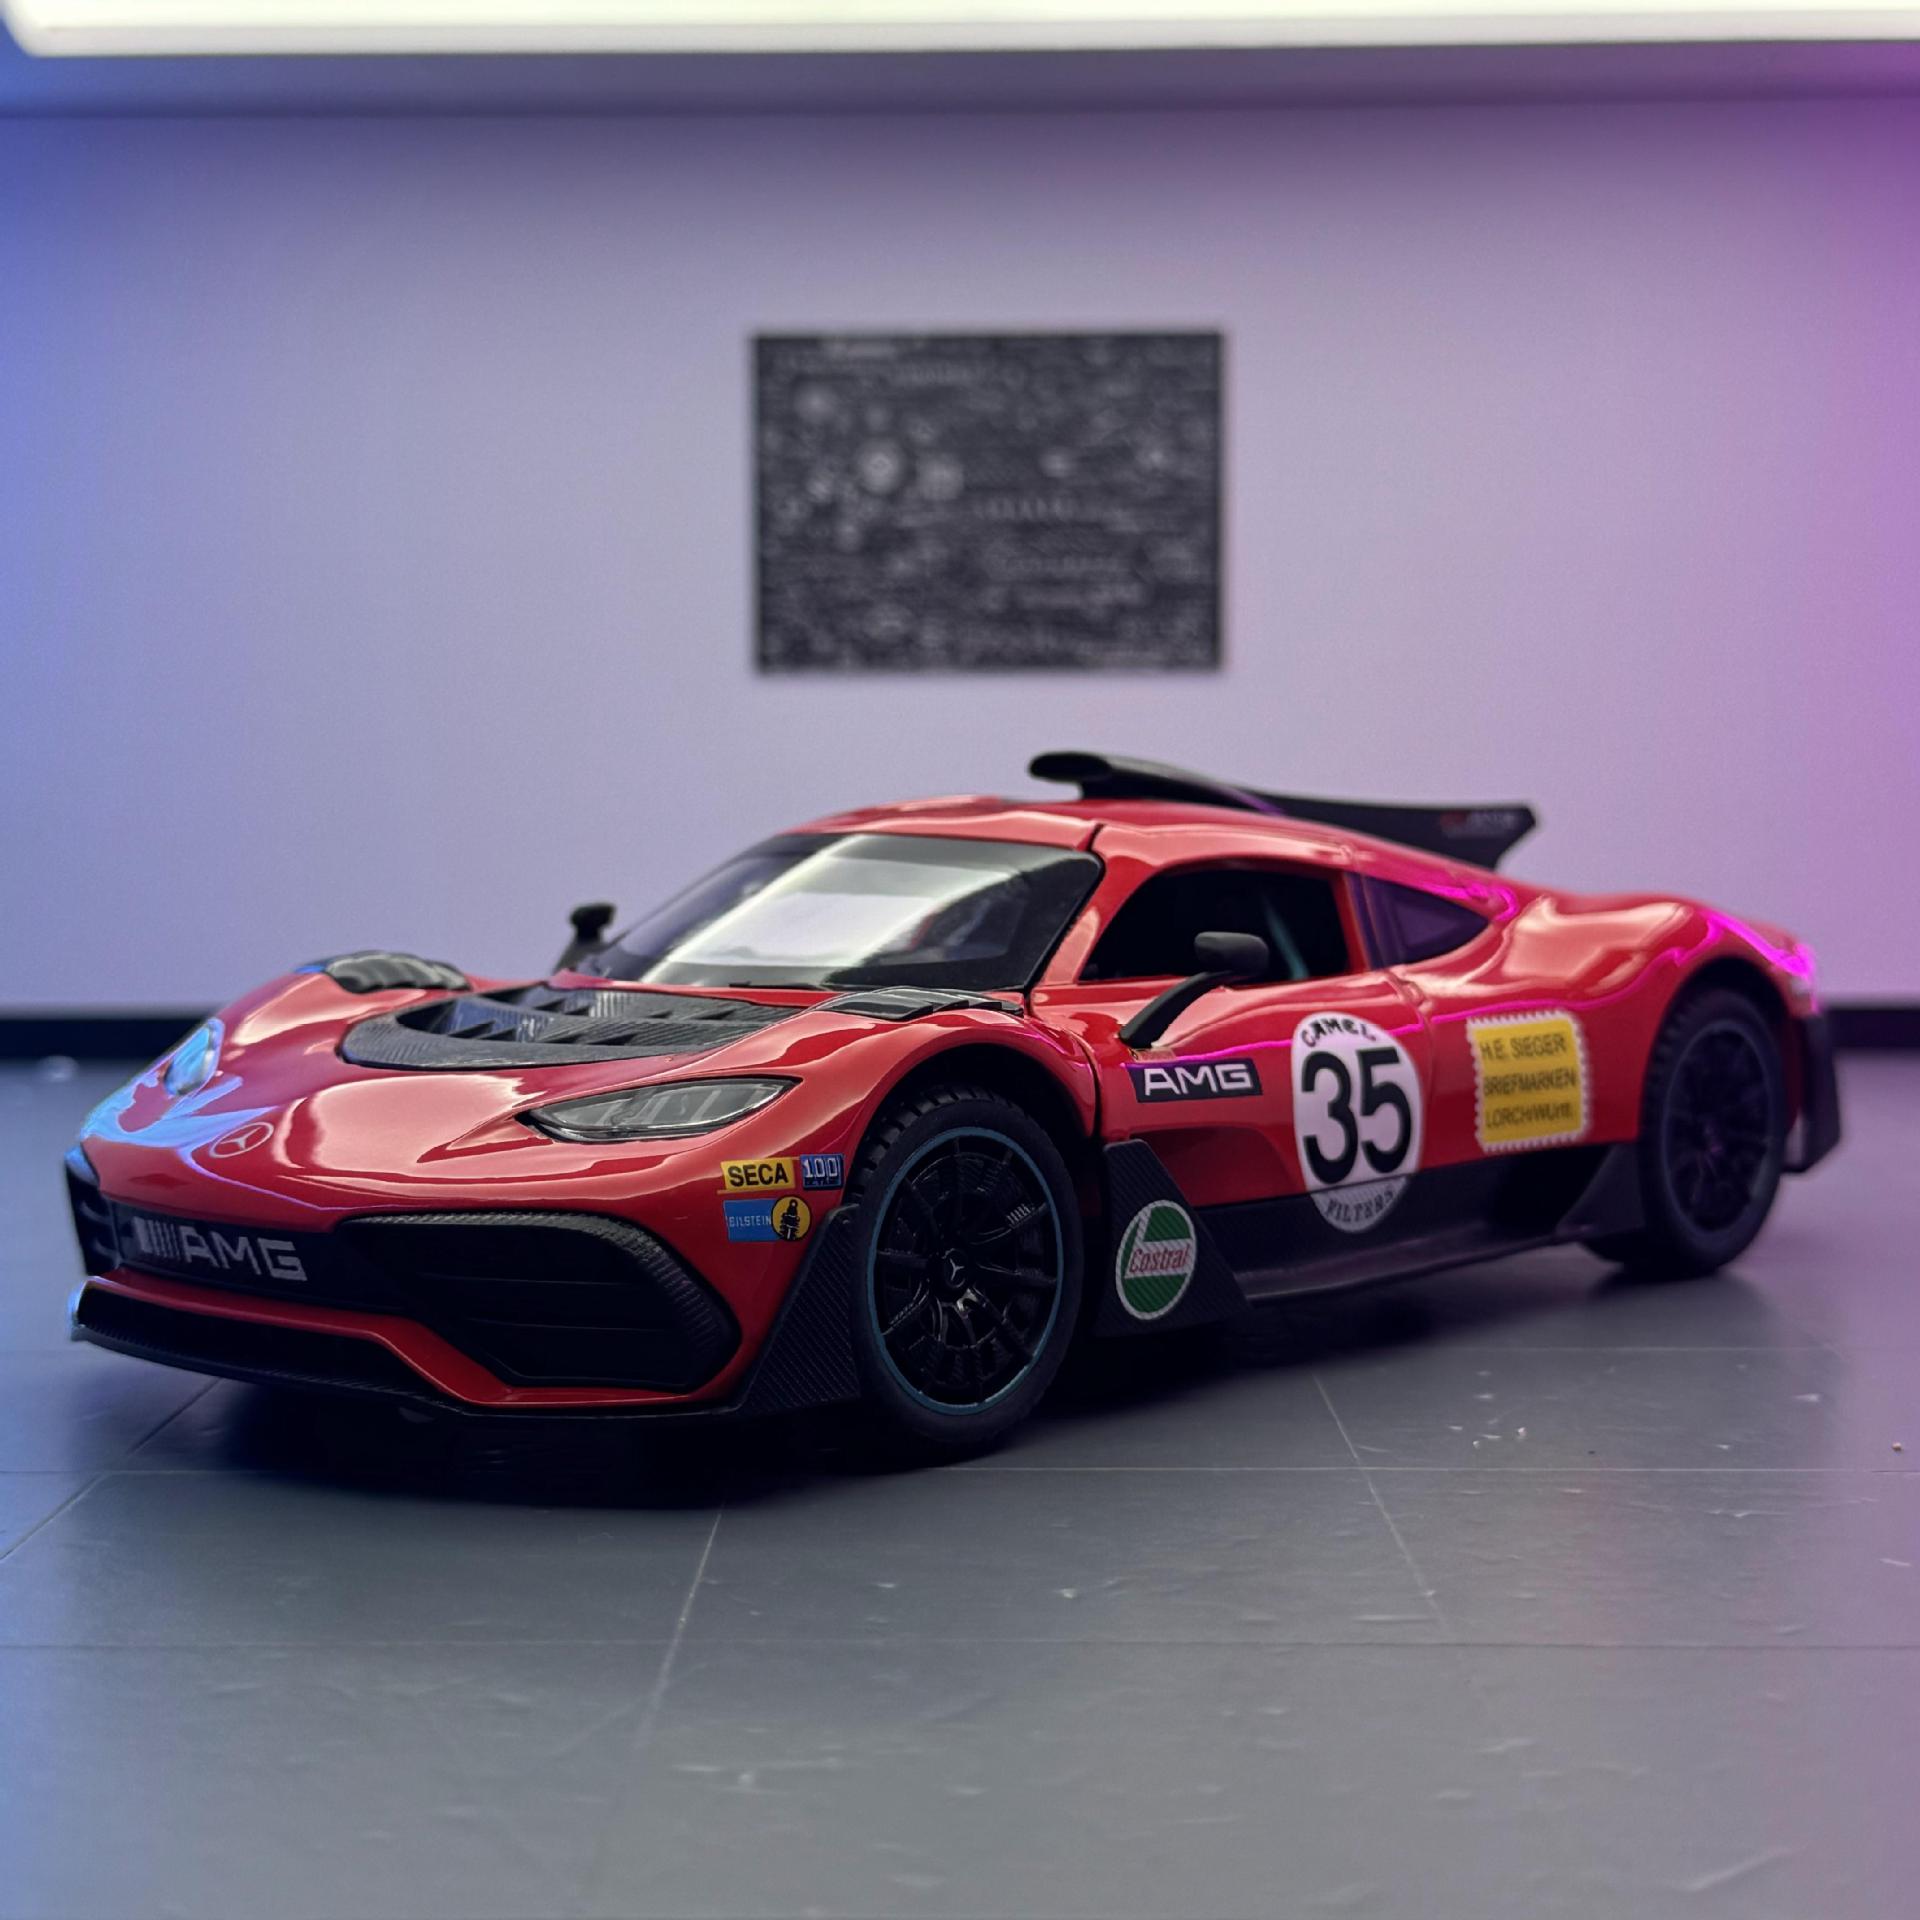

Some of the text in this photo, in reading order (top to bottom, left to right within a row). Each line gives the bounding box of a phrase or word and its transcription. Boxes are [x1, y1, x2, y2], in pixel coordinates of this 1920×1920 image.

[1301, 1017, 1378, 1049] CAMEL
[1510, 1033, 1567, 1059] SIEGER
[1143, 1063, 1253, 1097] AMG
[1302, 1046, 1412, 1185] 35
[727, 1162, 789, 1188] SECA
[803, 1156, 838, 1179] 100
[179, 1225, 308, 1282] AMG
